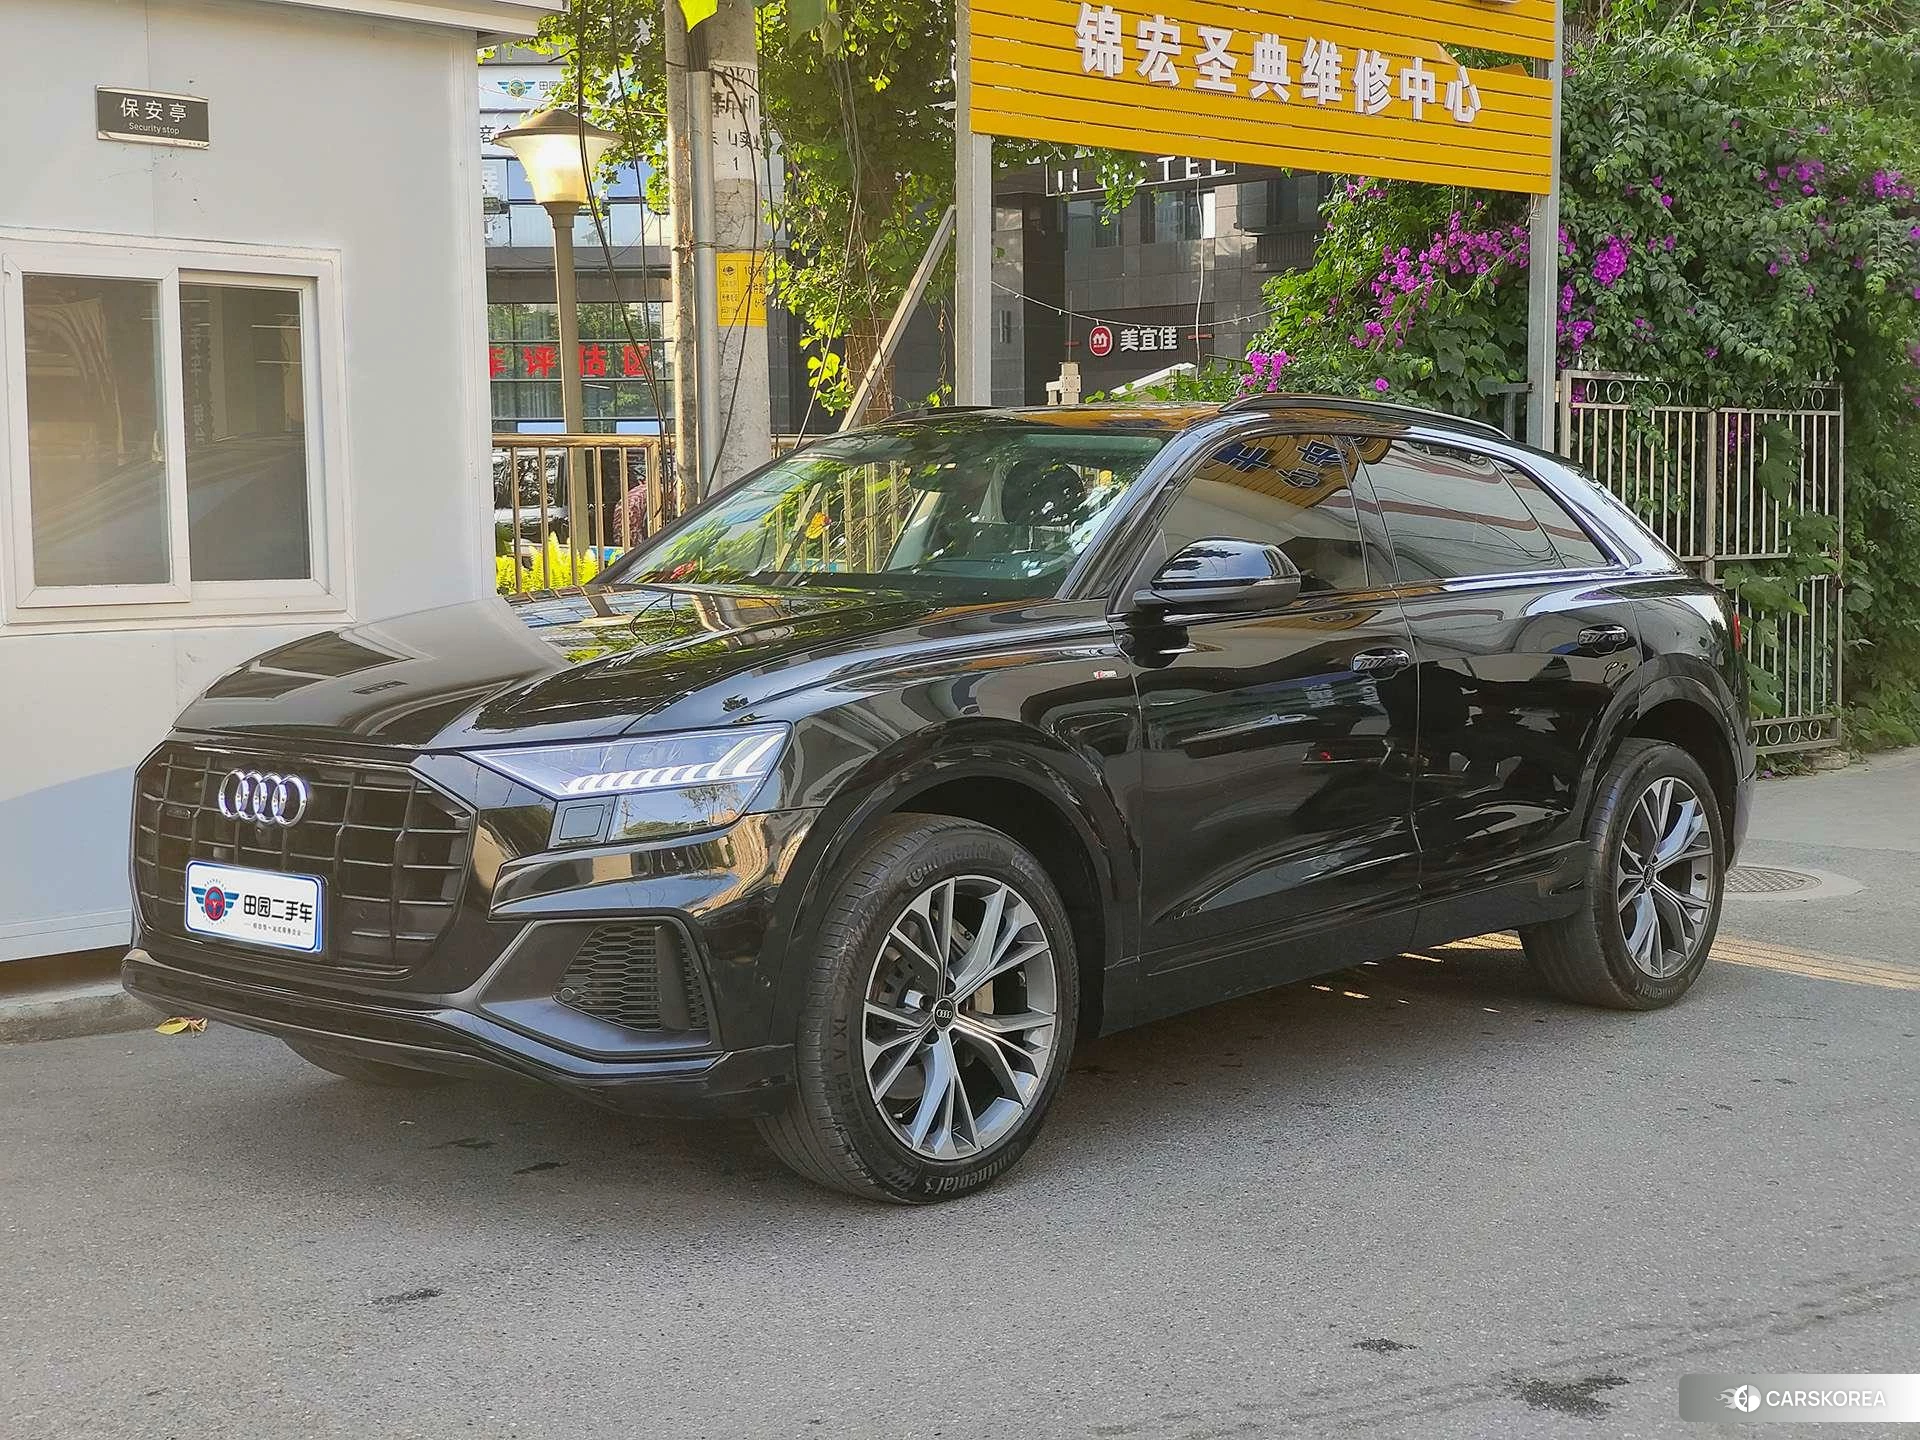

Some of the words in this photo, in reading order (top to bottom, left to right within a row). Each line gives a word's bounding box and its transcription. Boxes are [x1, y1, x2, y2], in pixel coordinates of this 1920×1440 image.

[1076, 2, 1482, 123] 锦宏圣典维修中心
[120, 97, 188, 123] 保安亭
[129, 122, 161, 134] Security
[162, 126, 180, 136] stop
[1120, 326, 1178, 352] 美宜佳
[244, 894, 313, 924] 田园二手车
